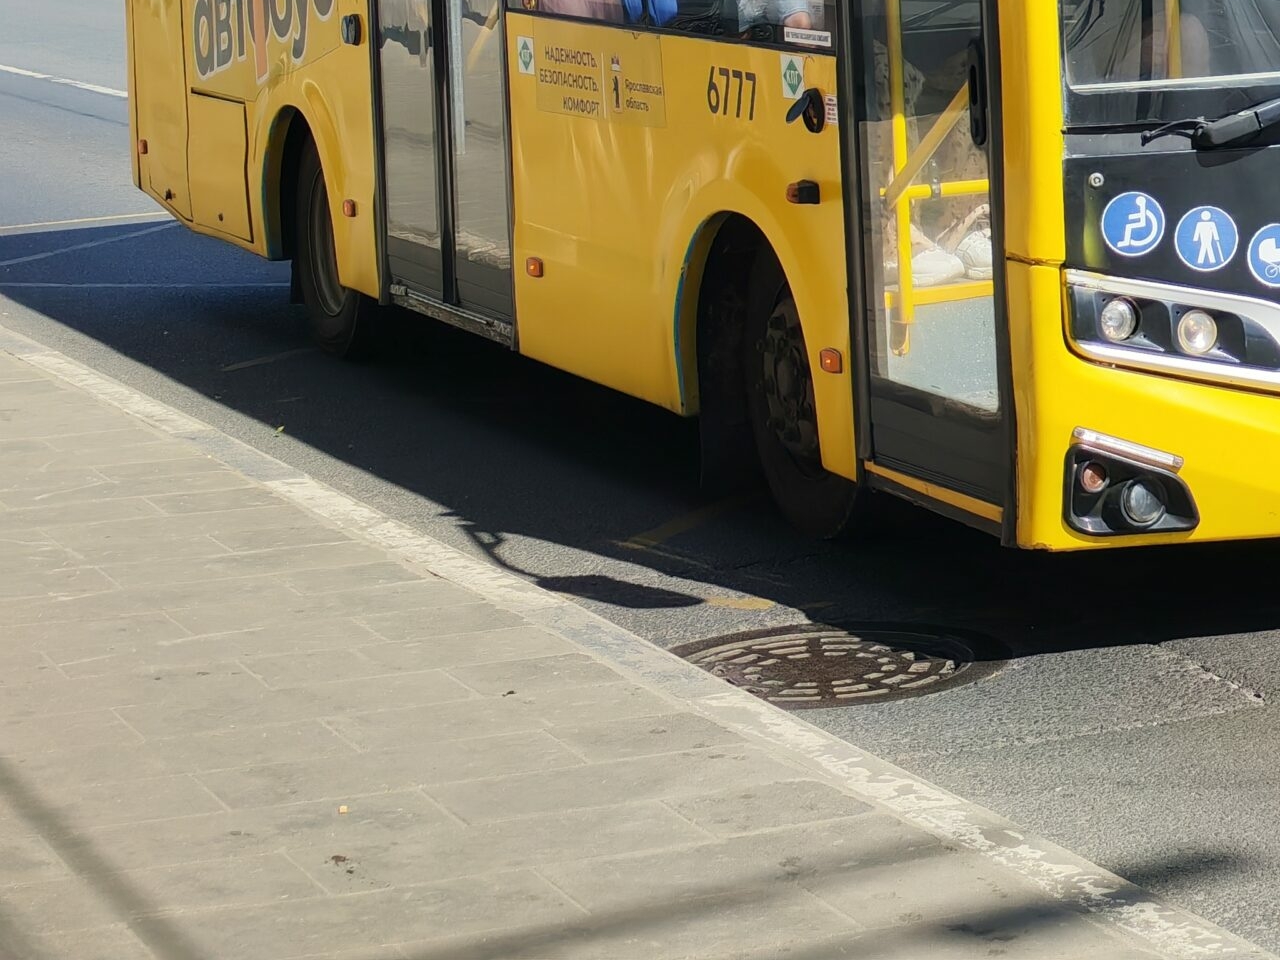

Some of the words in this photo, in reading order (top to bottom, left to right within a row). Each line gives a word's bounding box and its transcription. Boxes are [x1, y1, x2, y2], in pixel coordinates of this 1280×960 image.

[624, 78, 663, 97] Ярославская
[707, 65, 757, 122] 6777
[562, 96, 600, 117] КОМФОРТ
[625, 96, 650, 112] область
